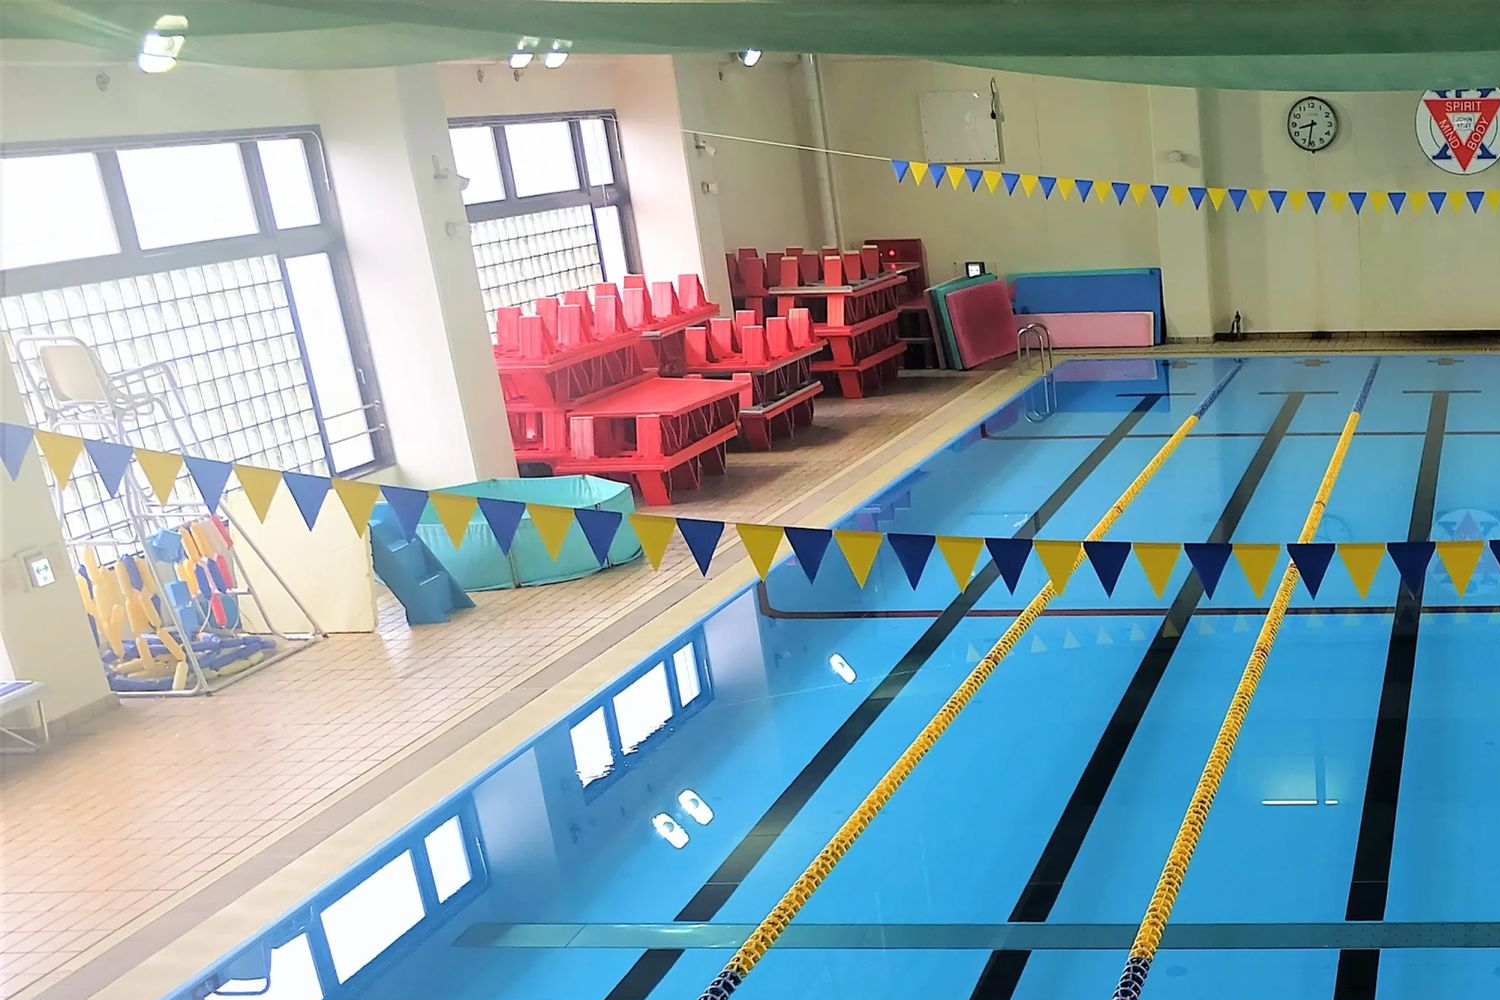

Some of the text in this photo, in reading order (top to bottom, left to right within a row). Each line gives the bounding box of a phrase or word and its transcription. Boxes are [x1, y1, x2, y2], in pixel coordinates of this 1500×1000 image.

[1445, 101, 1482, 112] SPIRIT
[1439, 119, 1460, 149] MIND
[1467, 117, 1489, 150] BODY
